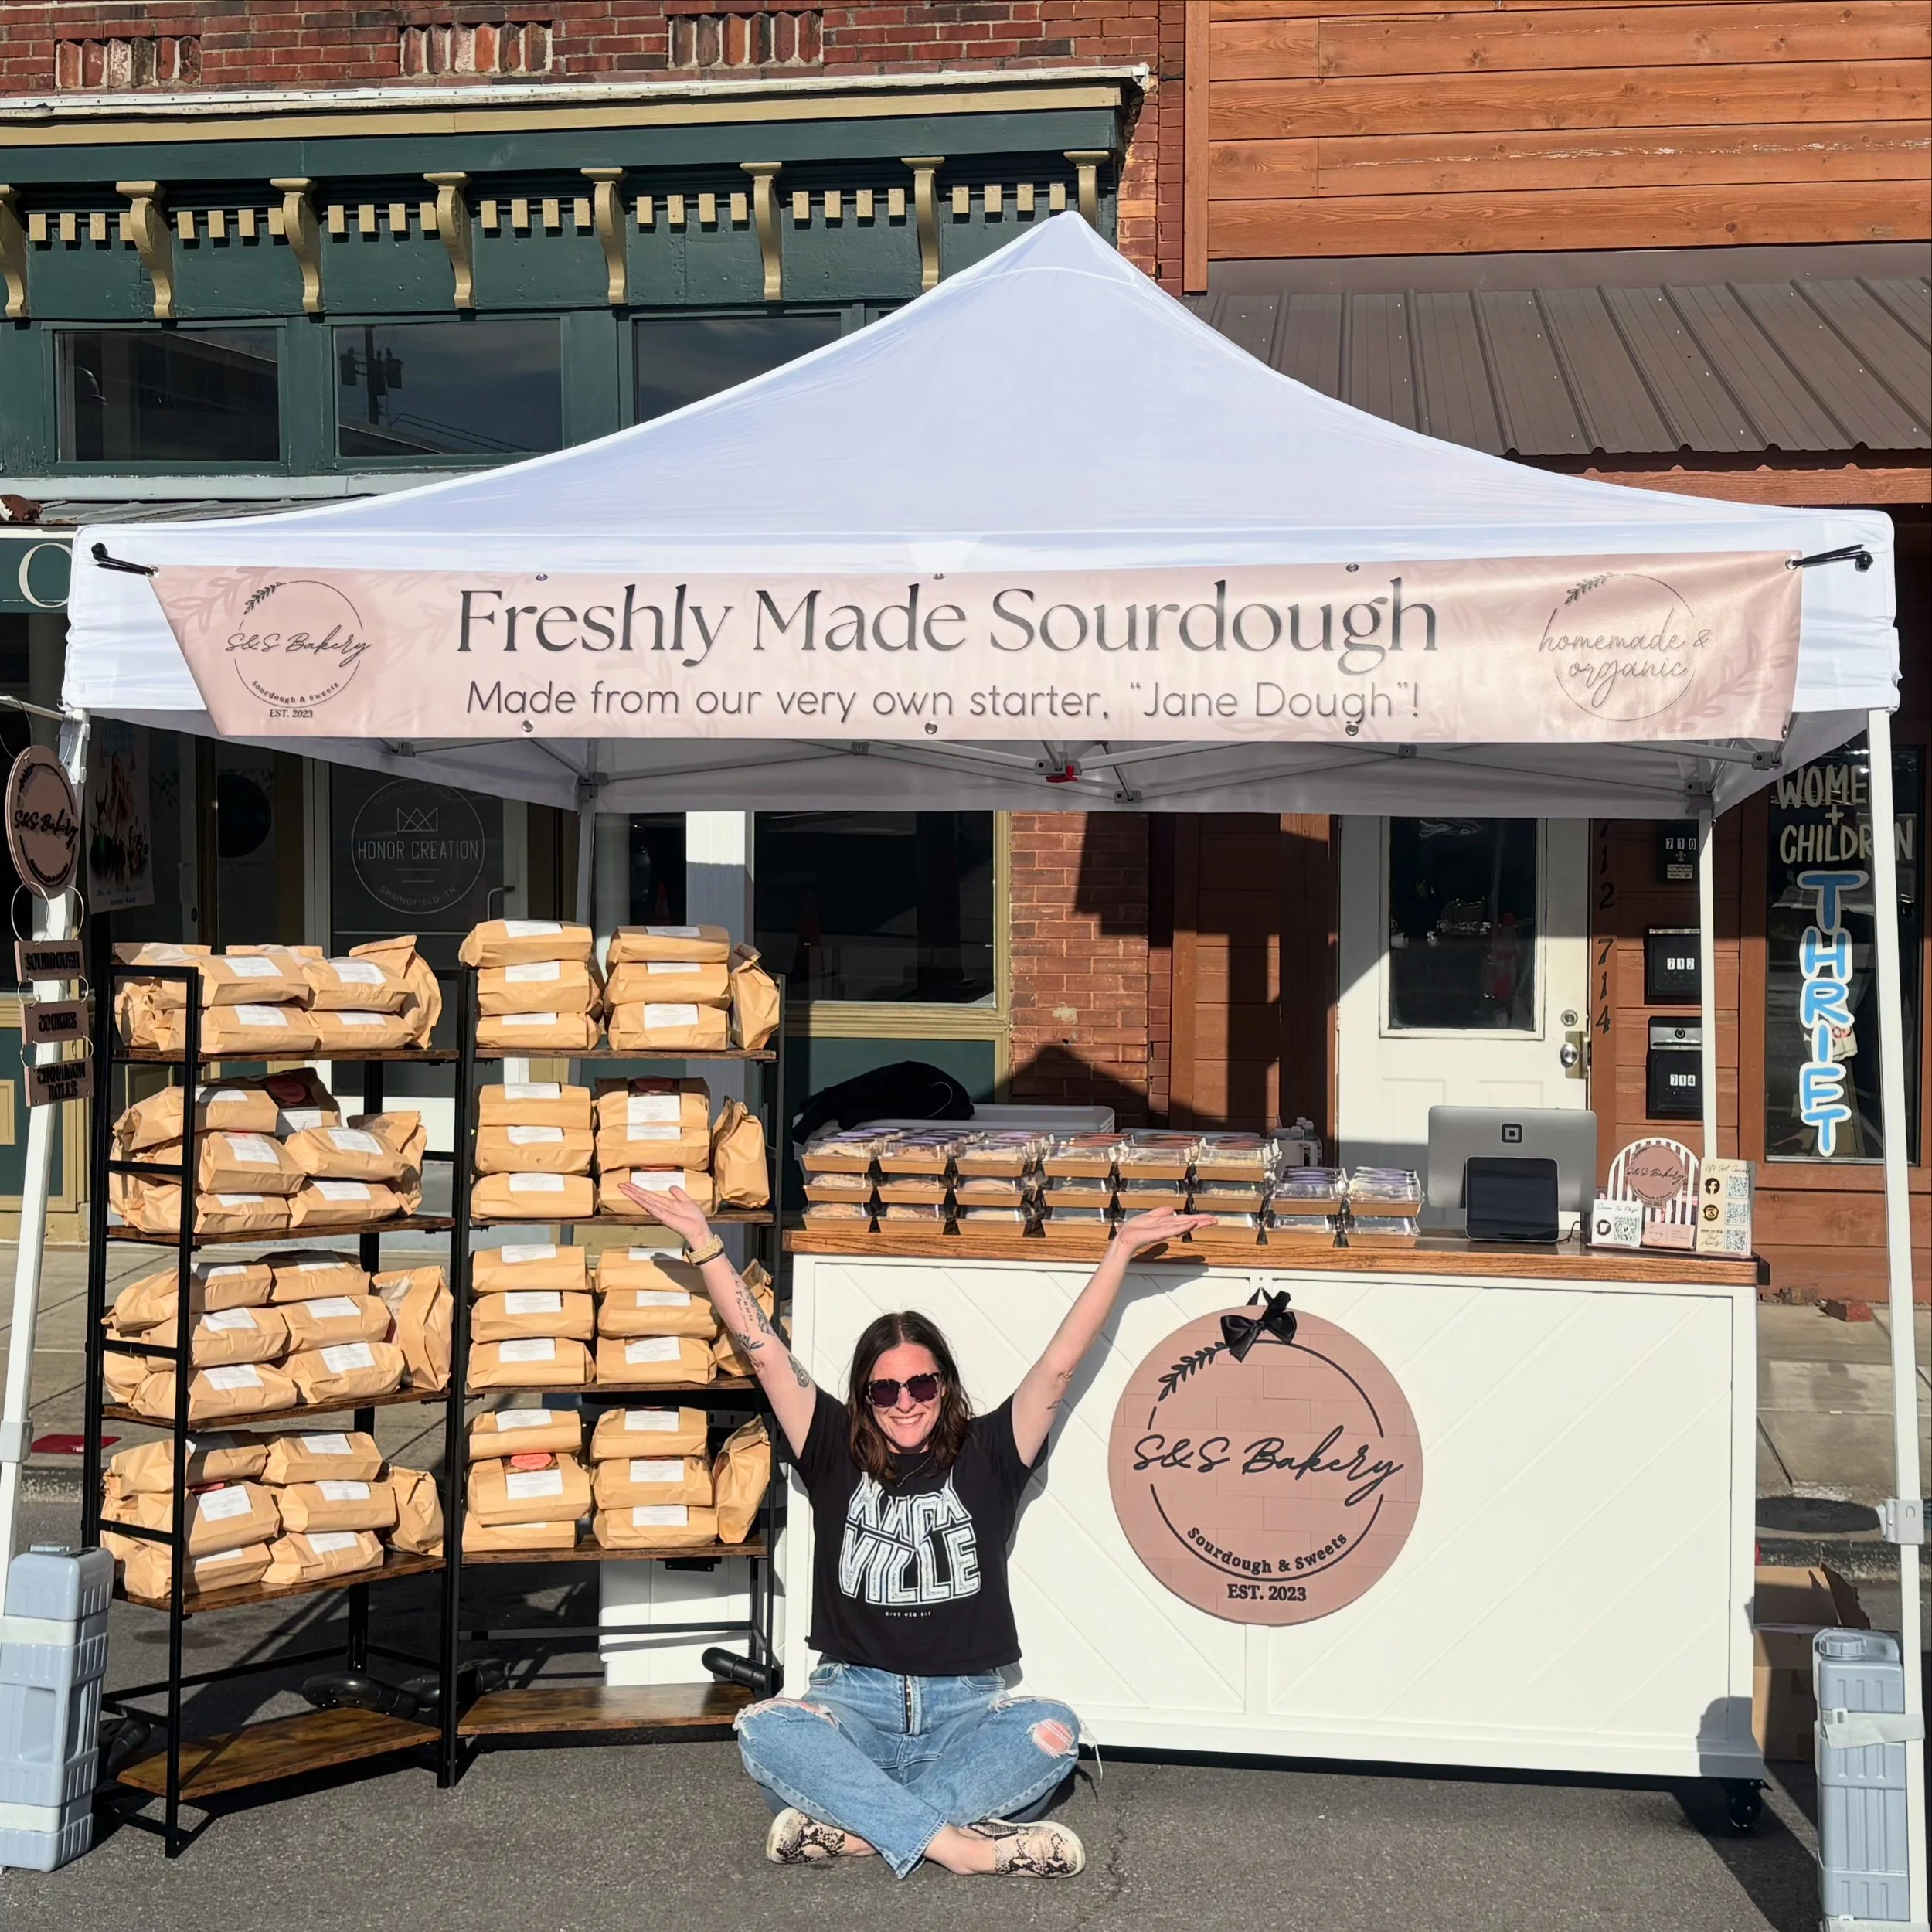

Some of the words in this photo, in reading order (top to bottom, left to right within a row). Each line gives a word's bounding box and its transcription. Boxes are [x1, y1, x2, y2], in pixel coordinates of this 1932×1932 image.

[226, 633, 280, 652] S&S
[286, 624, 372, 668] Bakery
[457, 583, 734, 667] Freshly
[753, 583, 965, 651] Made
[990, 577, 1437, 675] Sourdough
[1538, 607, 1685, 653] homemade
[1693, 629, 1711, 648] &
[252, 681, 296, 704] Sourdough
[309, 682, 339, 701] Sweets
[466, 680, 576, 715] Made
[591, 680, 679, 715] from
[696, 690, 762, 715] our
[777, 690, 855, 724] very
[872, 690, 953, 715] own
[970, 685, 1108, 720] starter,
[1130, 682, 1237, 717] “Jane
[1569, 658, 1687, 709] organic
[270, 709, 289, 718] EST.
[292, 709, 313, 718] 2023
[358, 840, 405, 859] HONOR
[411, 840, 478, 859] CREATION
[1665, 838, 1696, 850] 710
[1780, 819, 1913, 864] CHILDRN
[379, 885, 440, 907] SPRINGFIELD
[1596, 938, 1614, 1034] 714
[1667, 958, 1695, 970] 712
[1797, 870, 1869, 1157] THRIFT
[1670, 1074, 1696, 1087] 714
[1650, 1165, 1687, 1185] Bakery
[1133, 1434, 1230, 1473] S&S
[1242, 1425, 1404, 1507] Bakery
[839, 1522, 981, 1606] VILLE
[1187, 1526, 1272, 1575] Sourdough
[1278, 1559, 1291, 1572] &
[1295, 1532, 1348, 1570] Sweets
[1227, 1583, 1264, 1600] EST.
[1268, 1585, 1306, 1601] 2023
